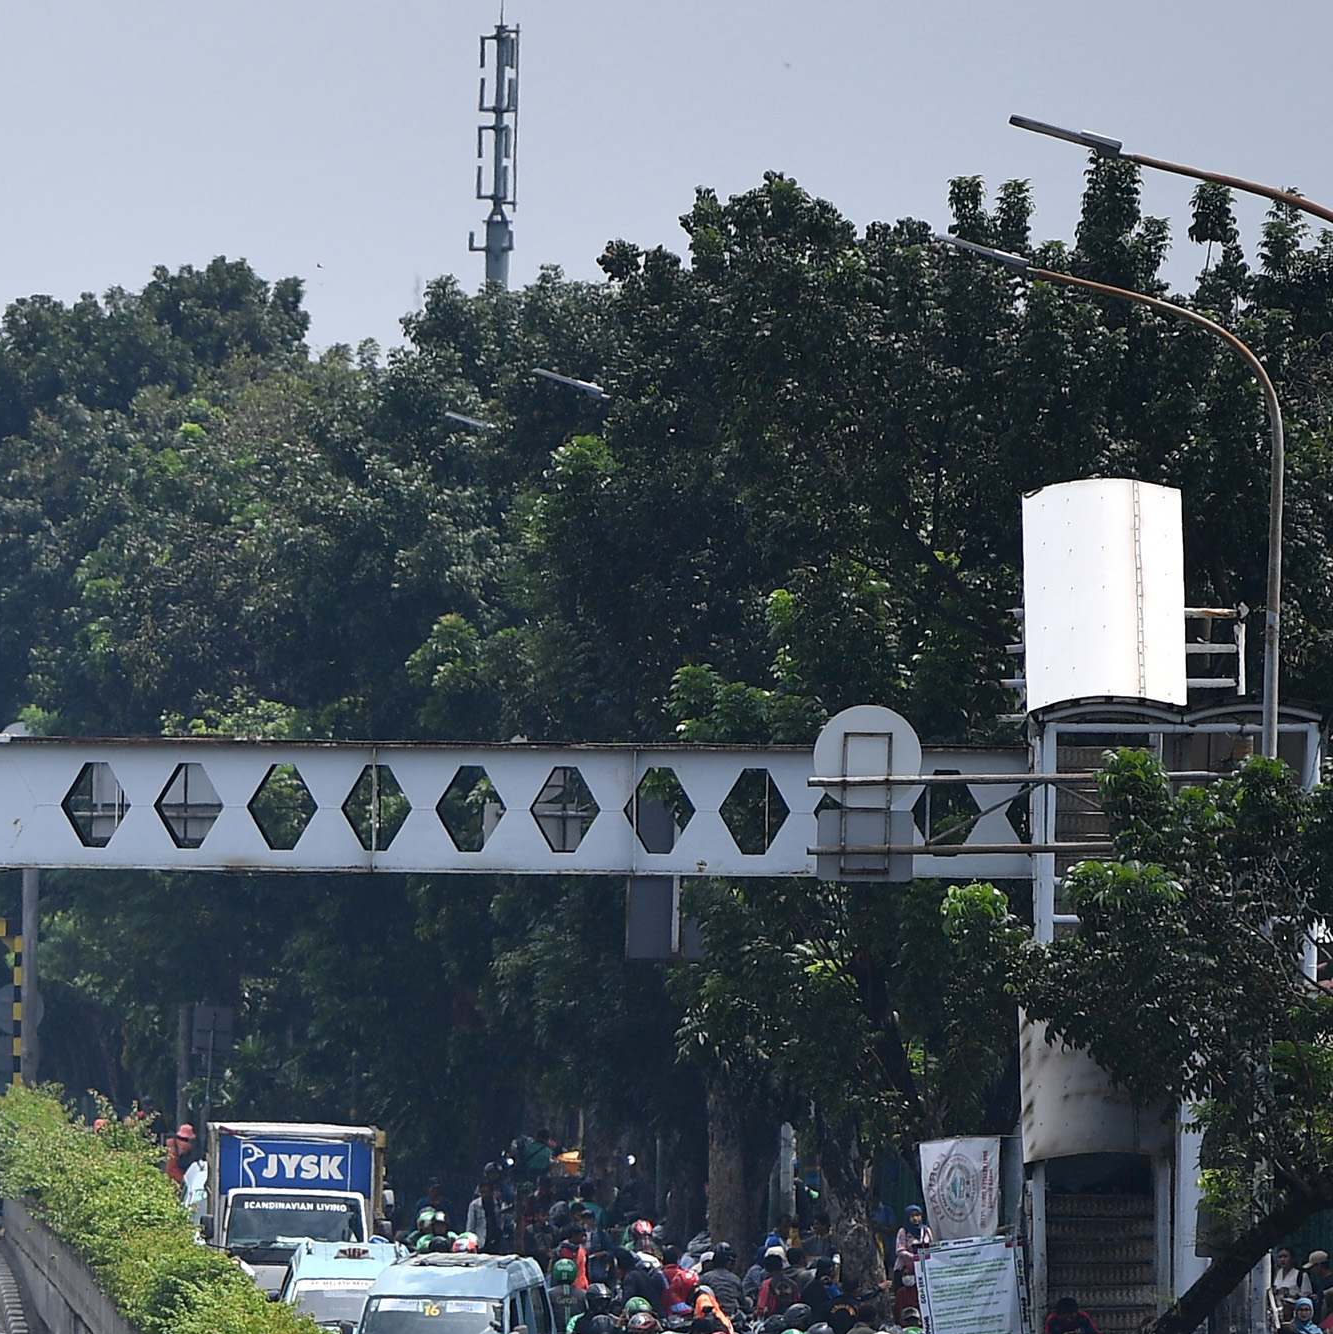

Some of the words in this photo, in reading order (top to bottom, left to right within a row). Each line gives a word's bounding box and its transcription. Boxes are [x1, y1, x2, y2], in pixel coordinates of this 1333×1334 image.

[262, 1154, 344, 1180] JYSK
[244, 1201, 314, 1211] SCANDINAVIAN
[316, 1202, 347, 1213] LIVING
[424, 1305, 440, 1317] 16
